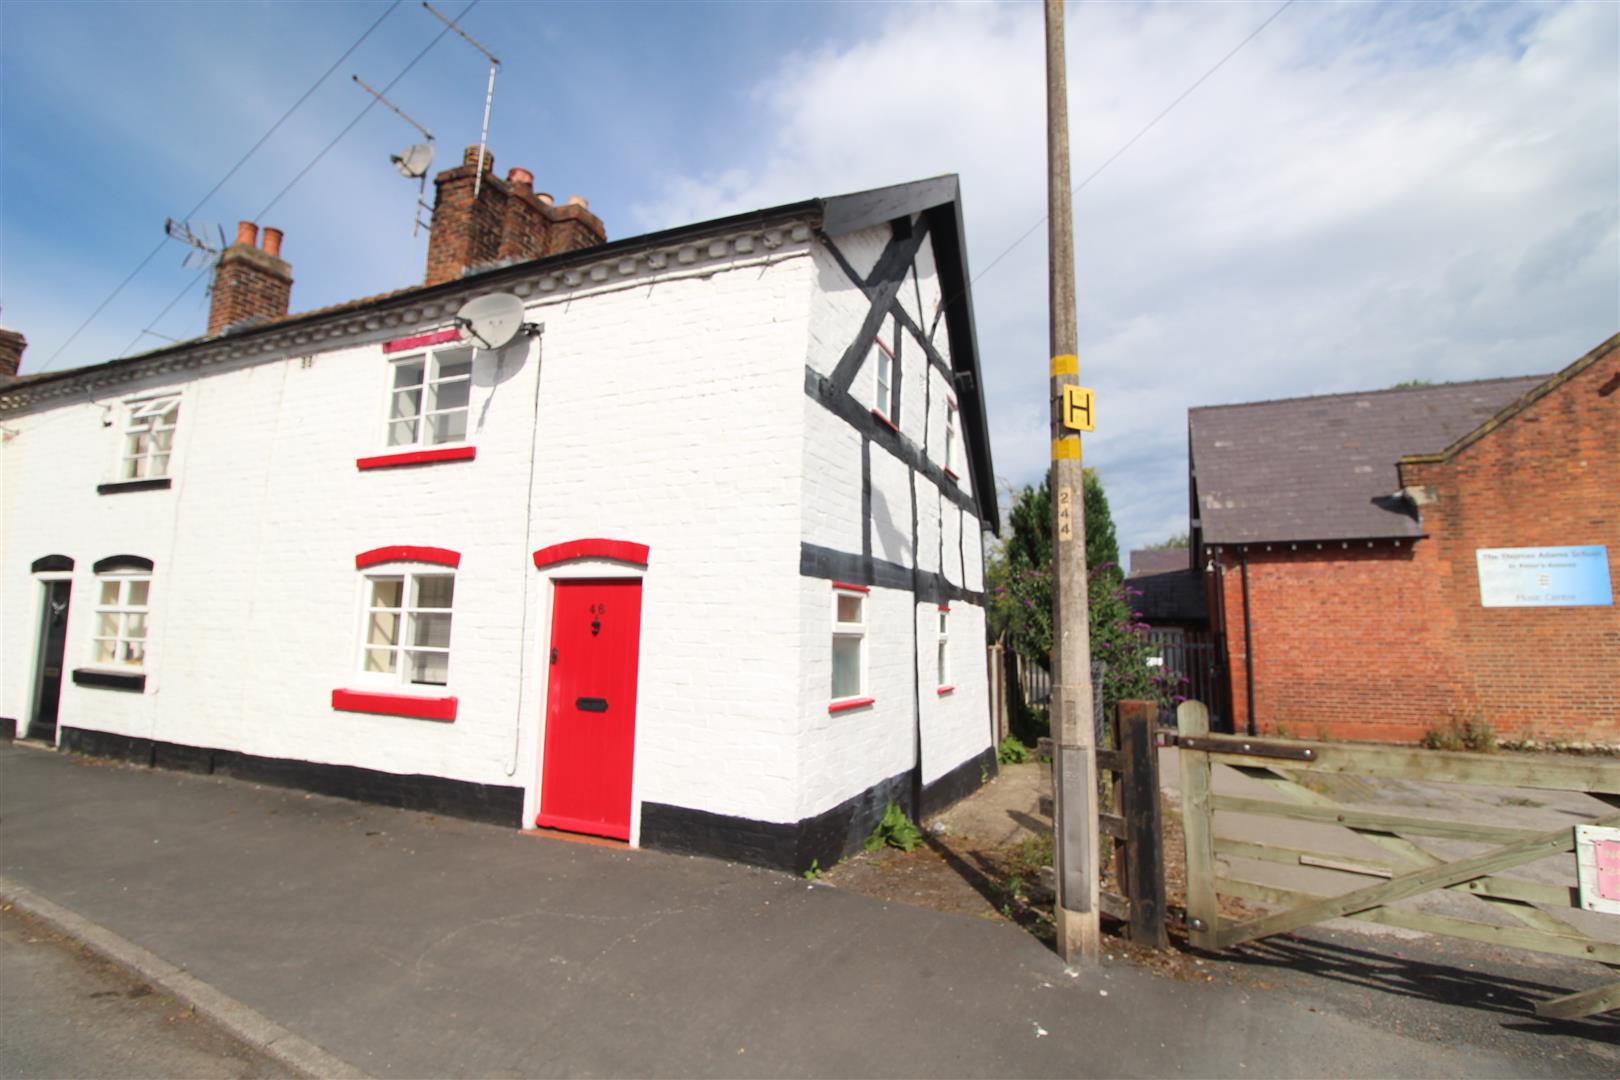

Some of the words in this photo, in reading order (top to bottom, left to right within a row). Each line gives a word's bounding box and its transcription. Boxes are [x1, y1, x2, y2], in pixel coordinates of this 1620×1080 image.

[1069, 389, 1090, 426] H
[1060, 492, 1070, 535] 244
[589, 603, 606, 615] 46
